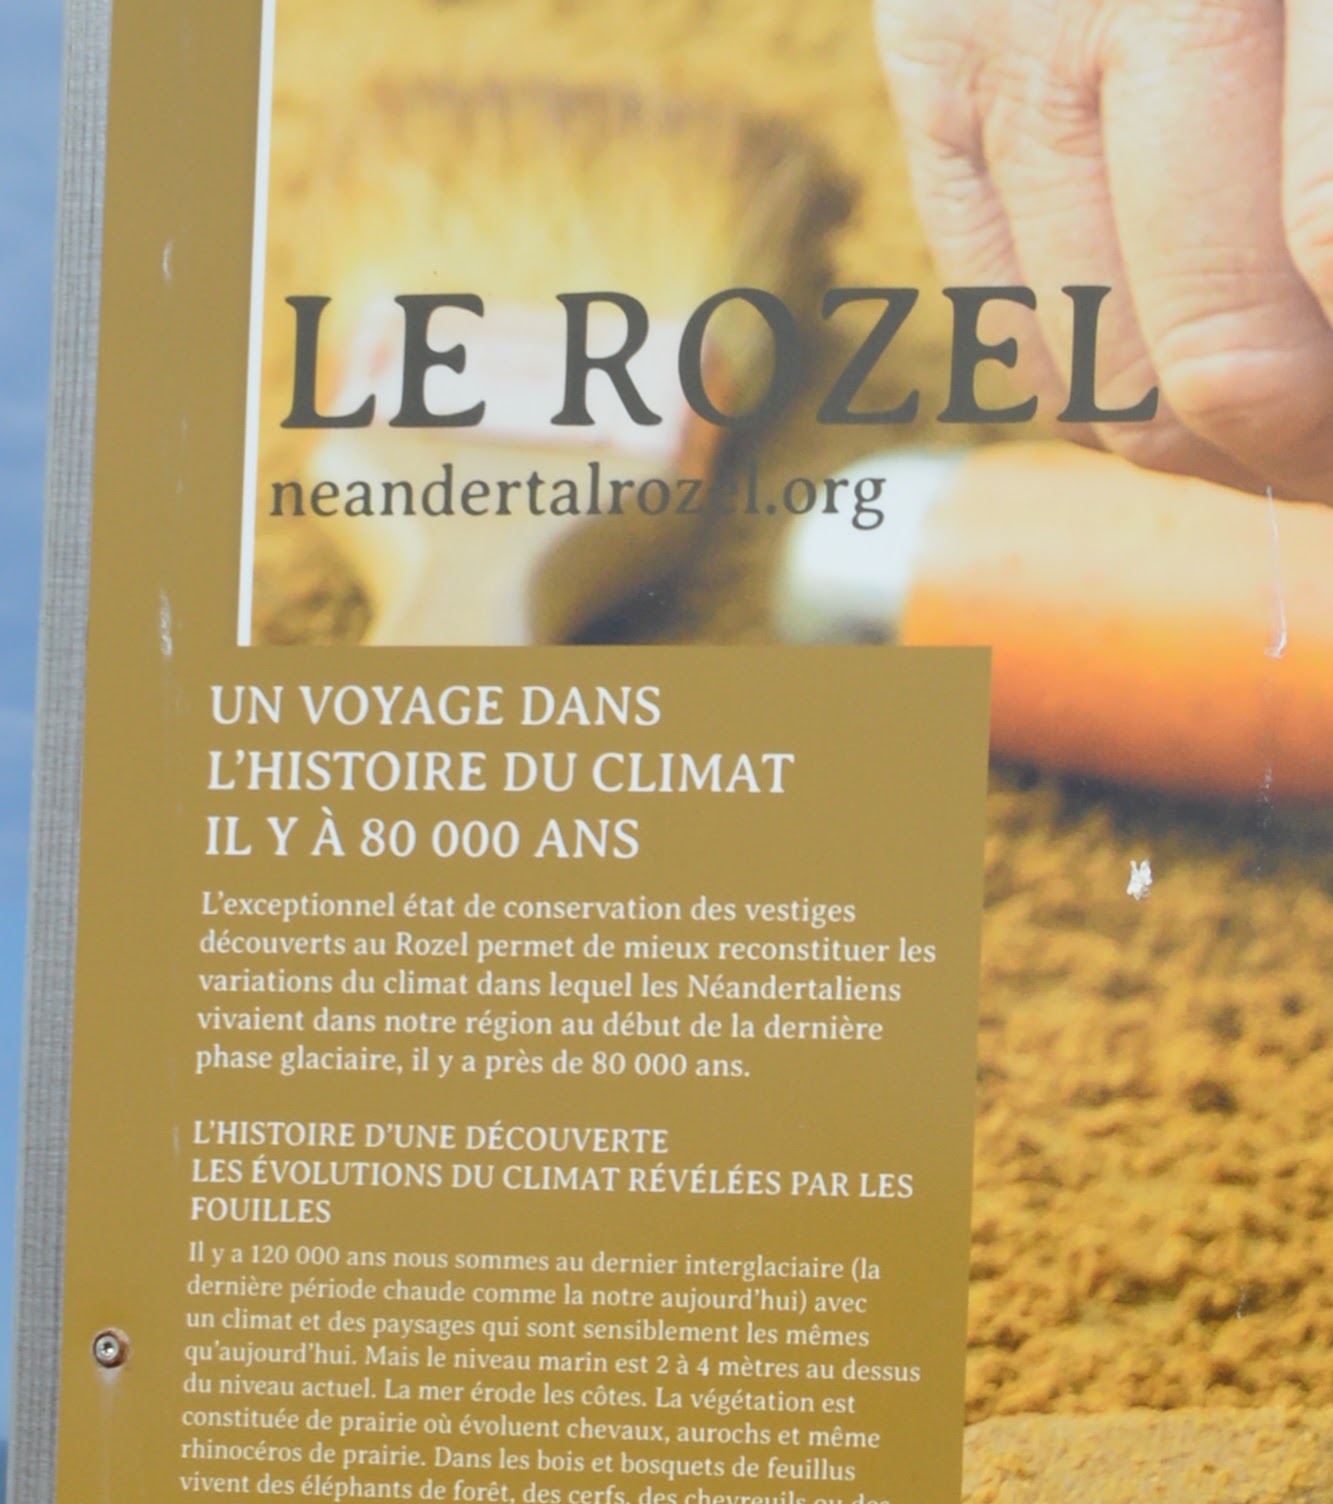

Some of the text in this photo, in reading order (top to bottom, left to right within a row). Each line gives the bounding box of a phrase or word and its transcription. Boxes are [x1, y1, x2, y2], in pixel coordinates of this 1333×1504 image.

[281, 283, 1160, 429] LE ROZEL
[269, 461, 887, 531] neandertalrozel.org
[211, 685, 661, 726] UN VOYAGE DANS
[208, 749, 795, 793] L’HISTOIRE DU CLIMAT
[206, 806, 639, 859] IL Y À 80 000 ANS
[194, 1120, 668, 1154] L’HISTOIRE D’UNE DÉCOUVERTE
